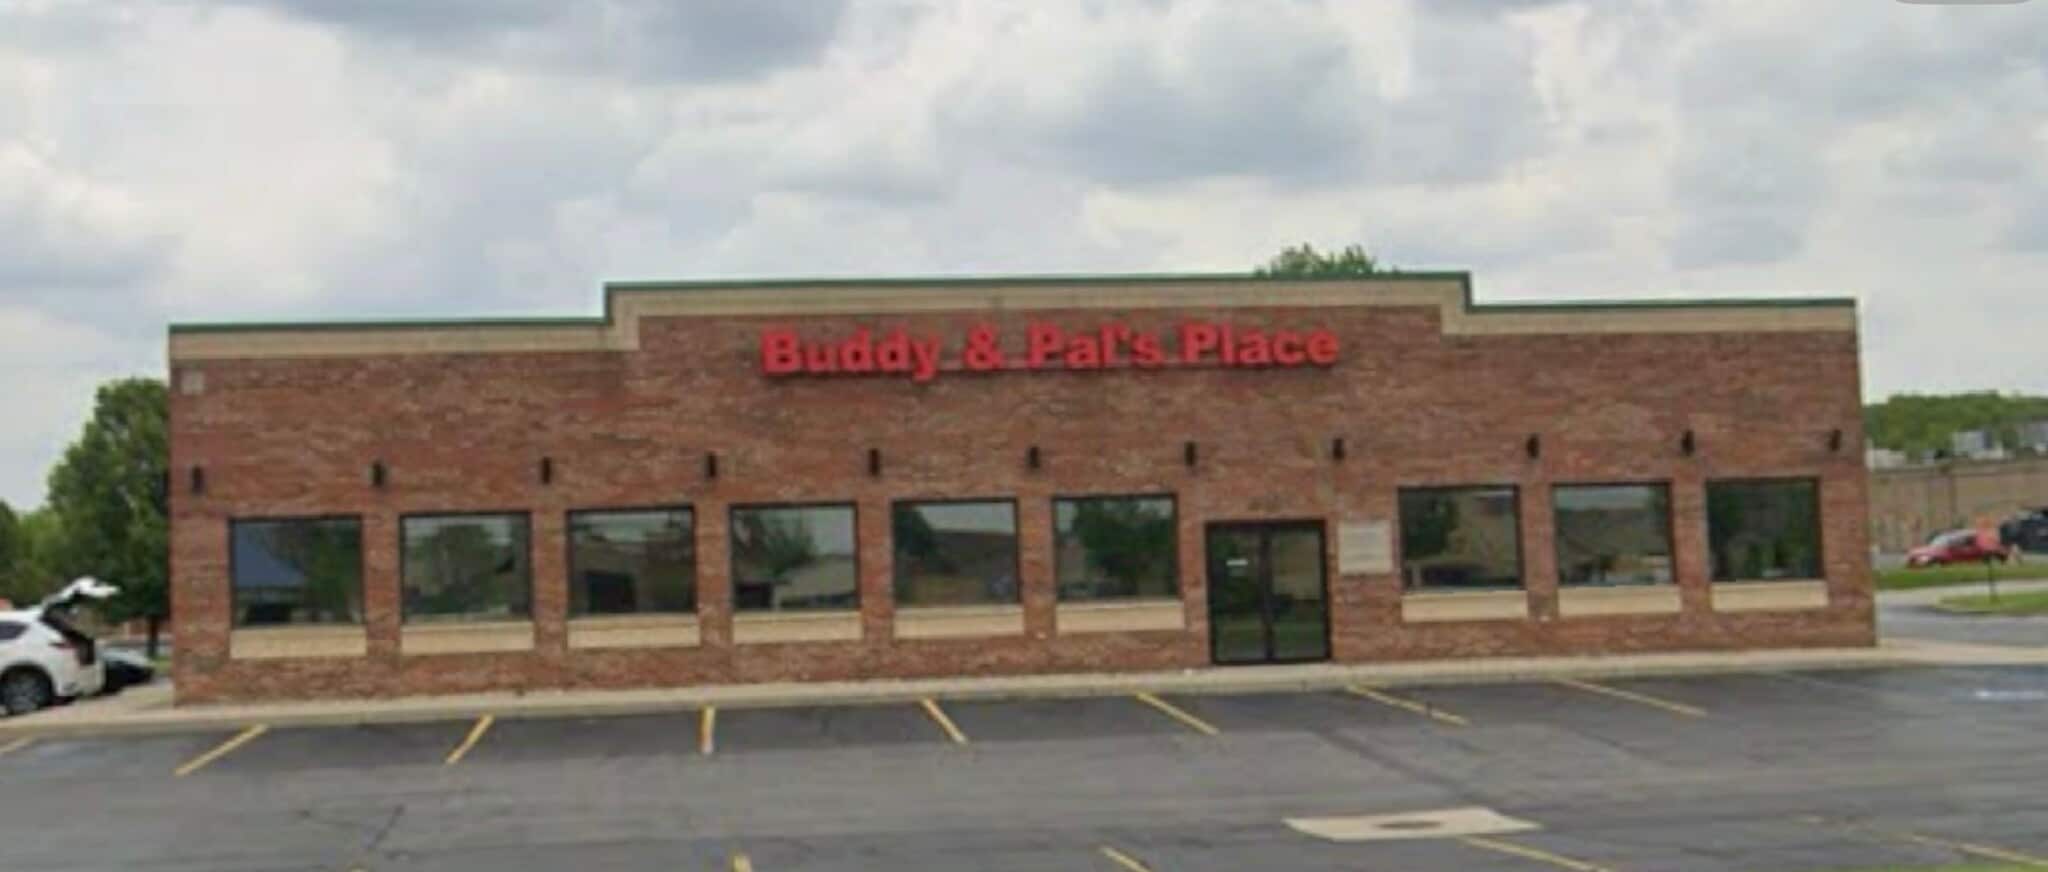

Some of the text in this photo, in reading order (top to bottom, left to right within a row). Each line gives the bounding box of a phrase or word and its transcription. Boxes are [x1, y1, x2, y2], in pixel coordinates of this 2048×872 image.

[761, 322, 1340, 380] Buddy & Pal's Place
